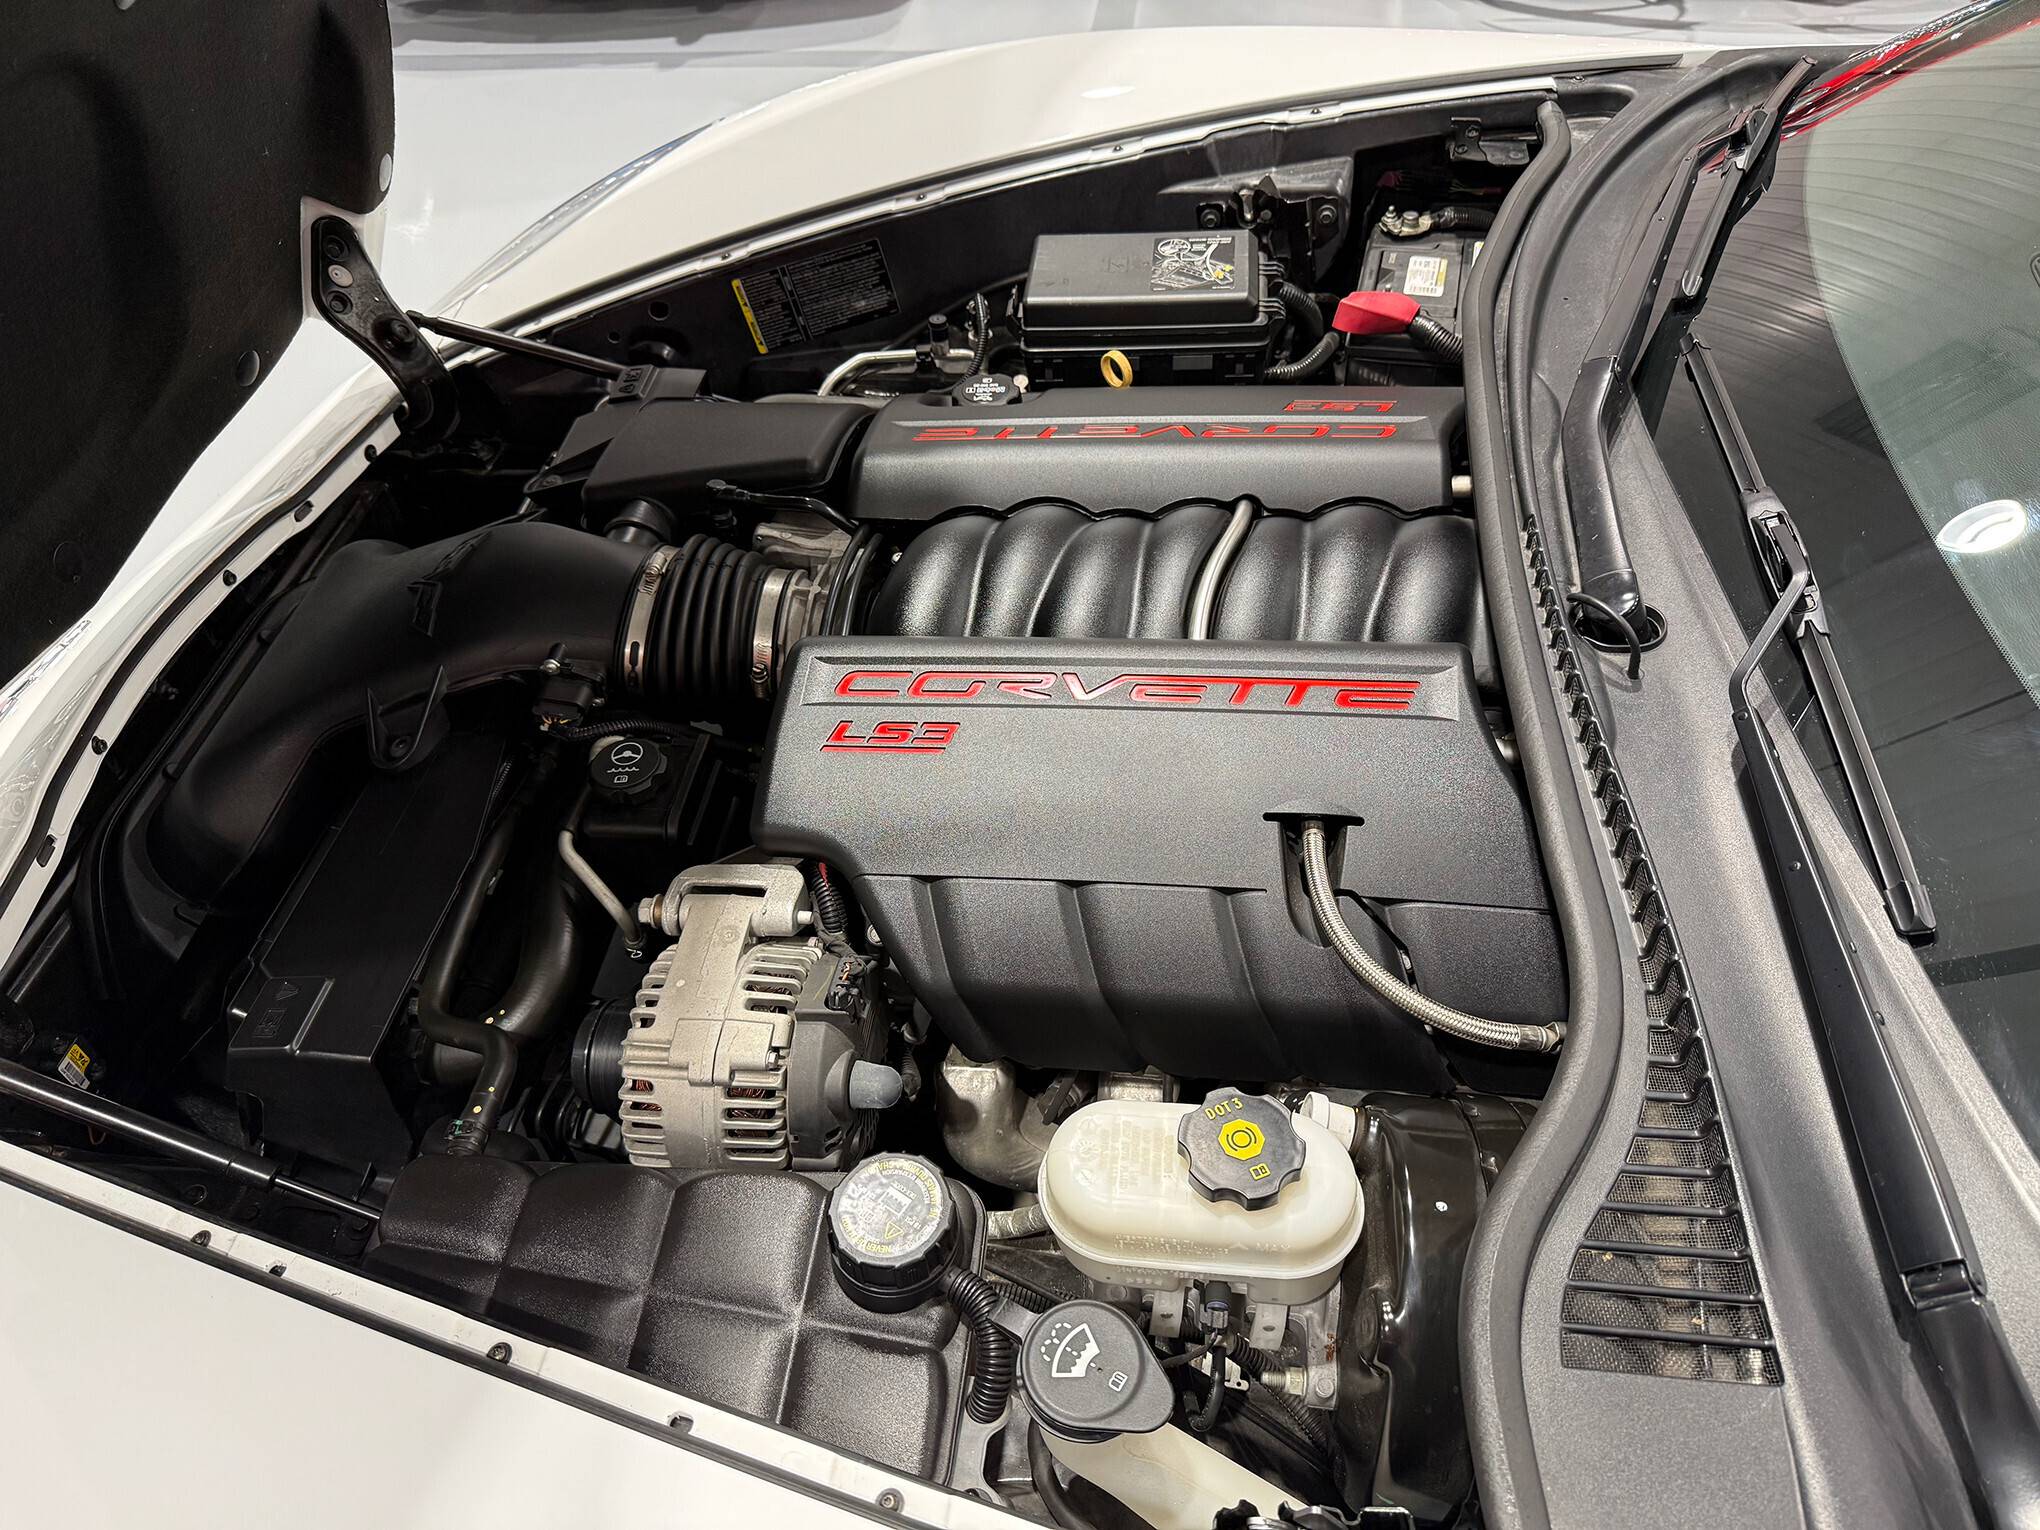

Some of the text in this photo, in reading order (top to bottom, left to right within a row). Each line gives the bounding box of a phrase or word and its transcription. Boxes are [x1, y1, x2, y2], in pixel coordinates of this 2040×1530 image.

[1285, 400, 1397, 412] LS3
[912, 424, 1396, 441] CORVETTE
[834, 670, 1420, 708] CORVETTE
[820, 721, 960, 752] LS3
[1205, 1097, 1243, 1120] DOT 3
